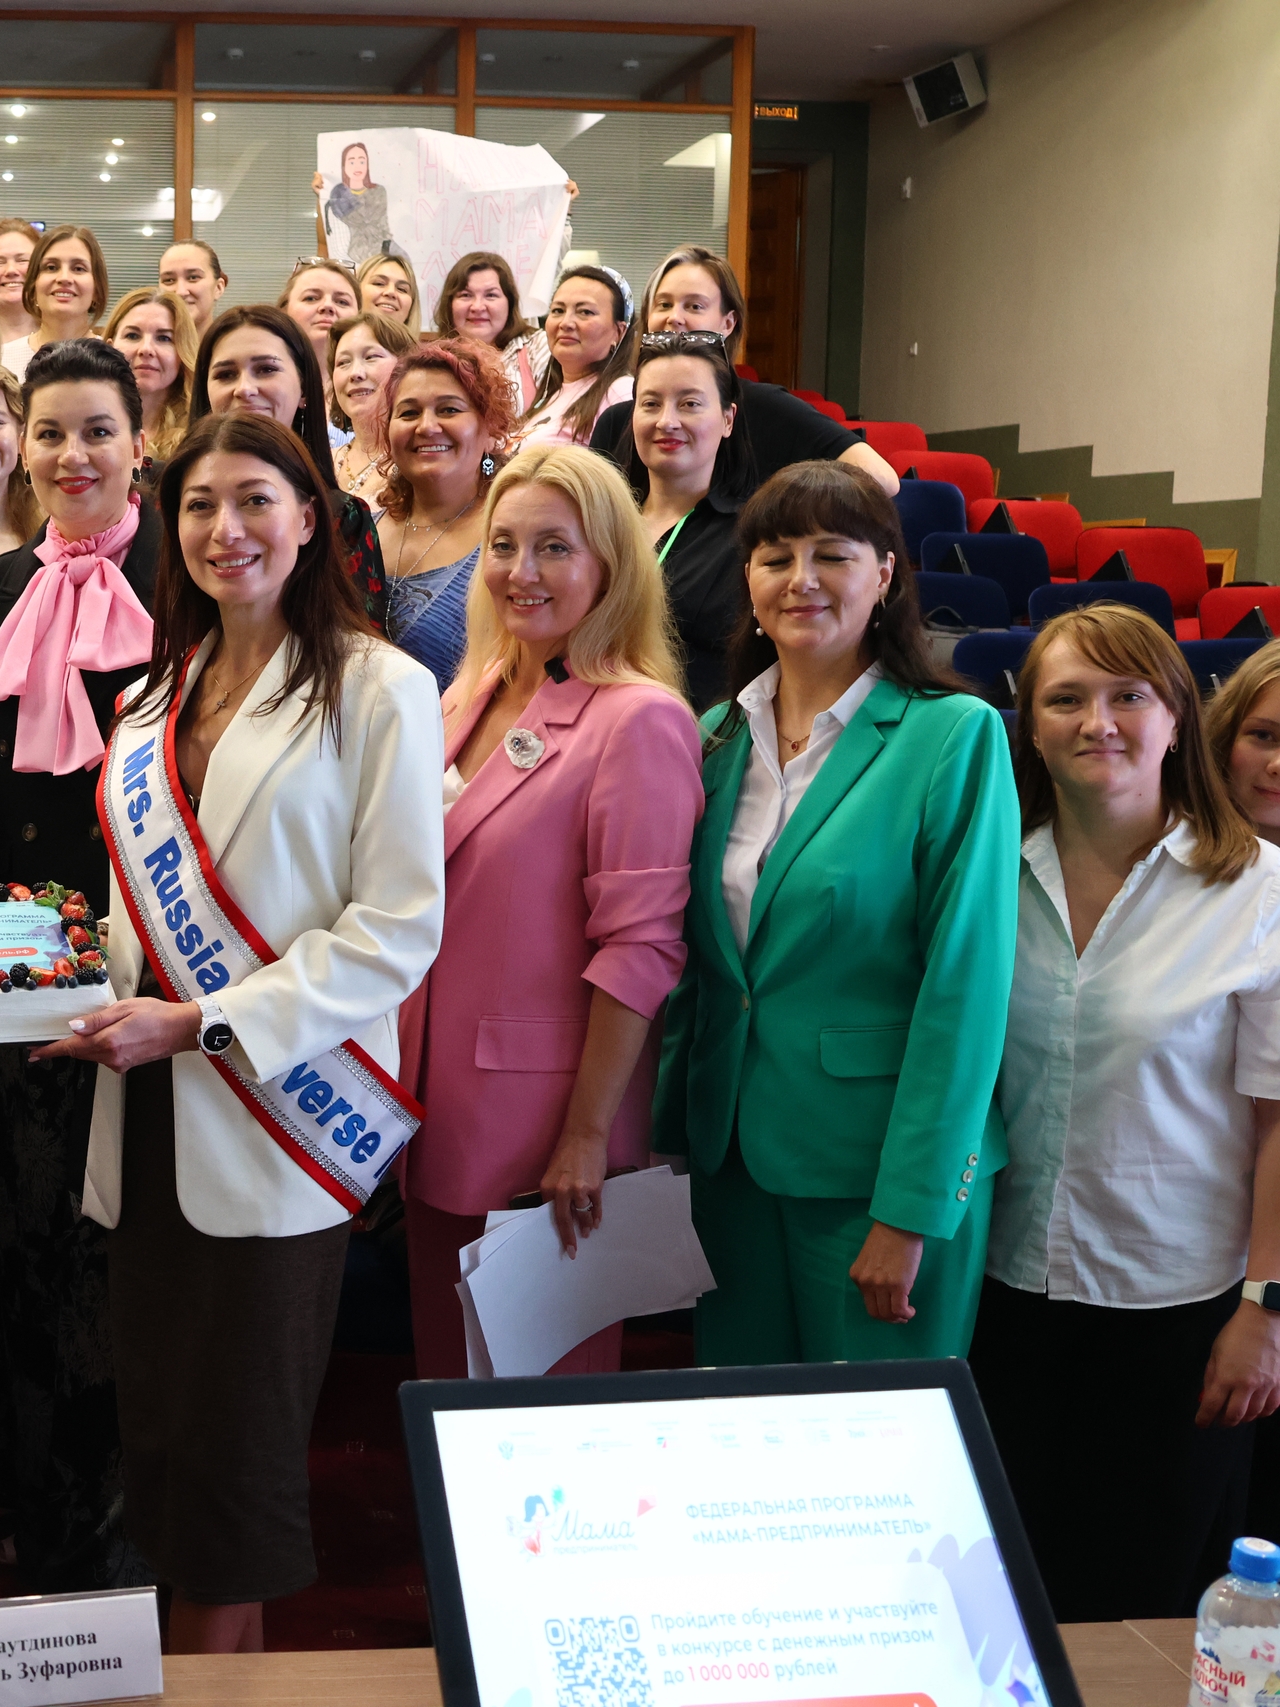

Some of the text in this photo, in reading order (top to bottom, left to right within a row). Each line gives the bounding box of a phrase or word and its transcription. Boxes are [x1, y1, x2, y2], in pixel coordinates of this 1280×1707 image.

[760, 106, 794, 118] ВЫХОД
[415, 192, 548, 246] МАМА
[123, 736, 230, 995] Mrs. Russia
[280, 1061, 381, 1164] verse
[686, 1493, 915, 1521] ФЕДЕРАЛЬНАЯ ПРОГРАММА
[551, 1509, 635, 1542] Мама
[693, 1518, 932, 1545] «МАМА-ПРЕДПРИНИМАТЕЛЬ»
[651, 1599, 939, 1633] Пройдите обучение и участвуйте
[657, 1628, 935, 1658] в конкурсе с денежным призом
[17, 1655, 123, 1682] Зуфаровна
[663, 1668, 685, 1686] до
[699, 1664, 732, 1682] 000
[737, 1662, 770, 1680] 000
[774, 1657, 839, 1681] рублей
[1194, 1652, 1246, 1688] АСНЫЙ
